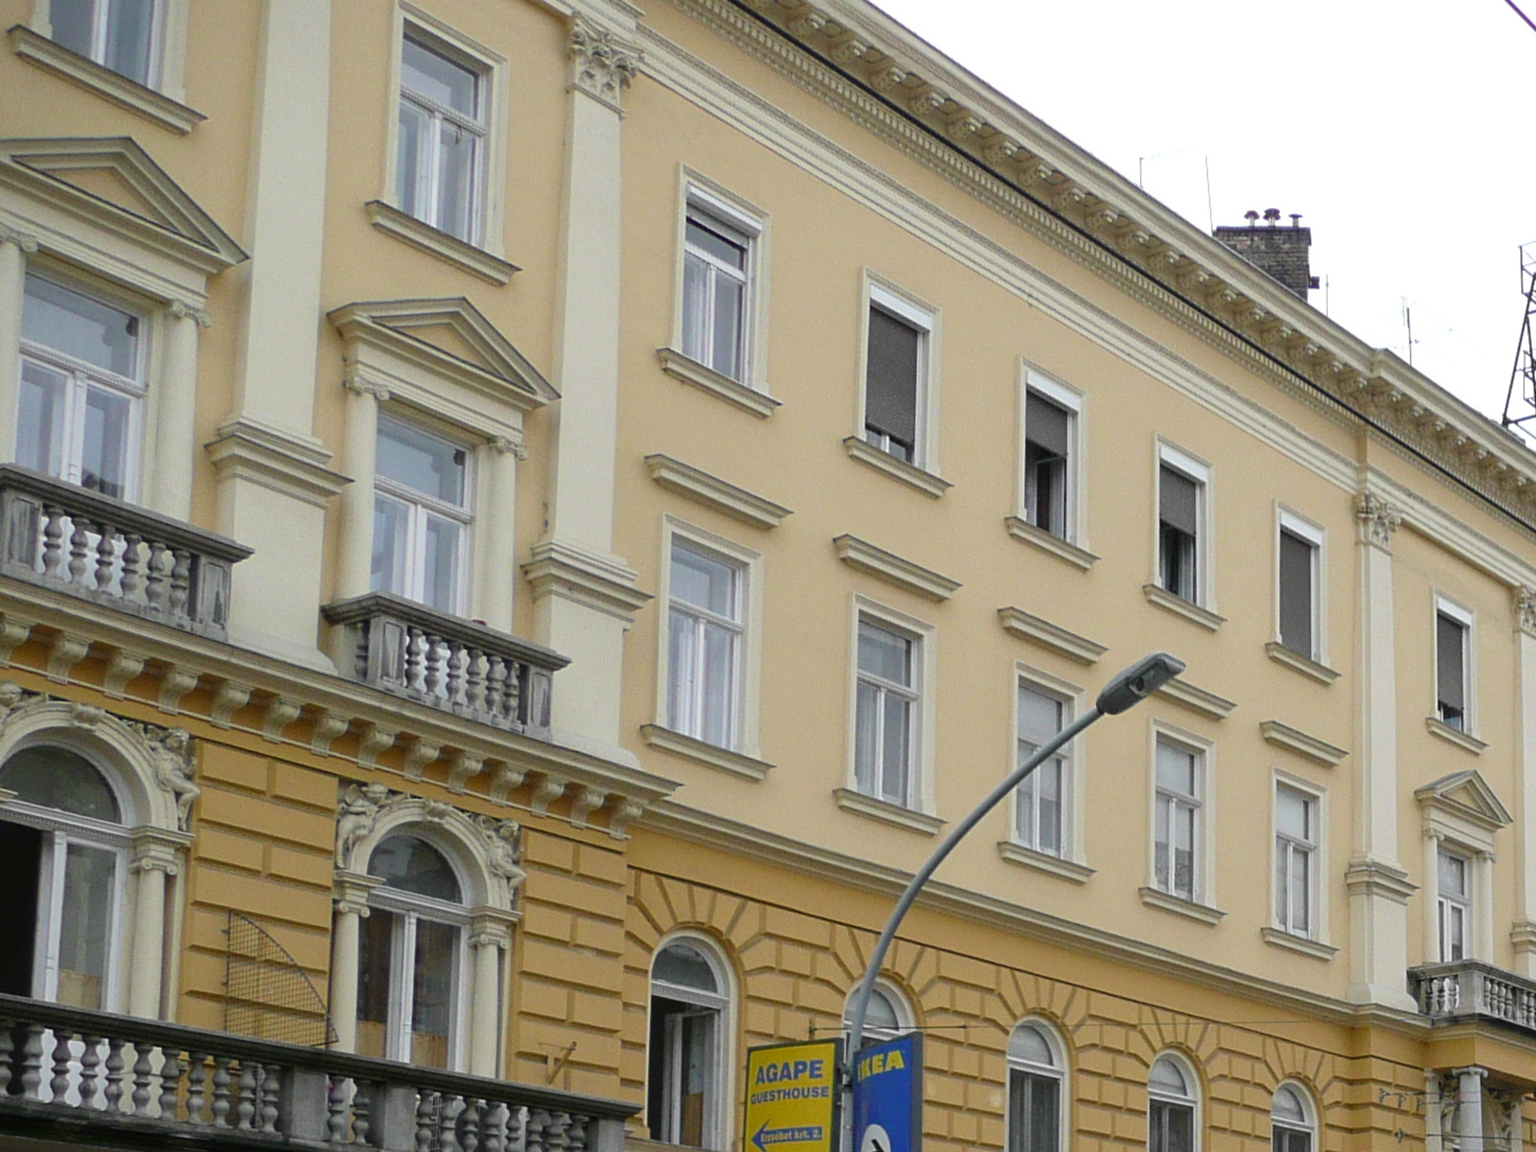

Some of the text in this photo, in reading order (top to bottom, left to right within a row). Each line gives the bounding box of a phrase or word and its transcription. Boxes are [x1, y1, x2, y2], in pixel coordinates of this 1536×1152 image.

[755, 1059, 824, 1085] AGAPE
[858, 1050, 904, 1082] IKEA
[751, 1086, 829, 1105] GUESTHOUSE
